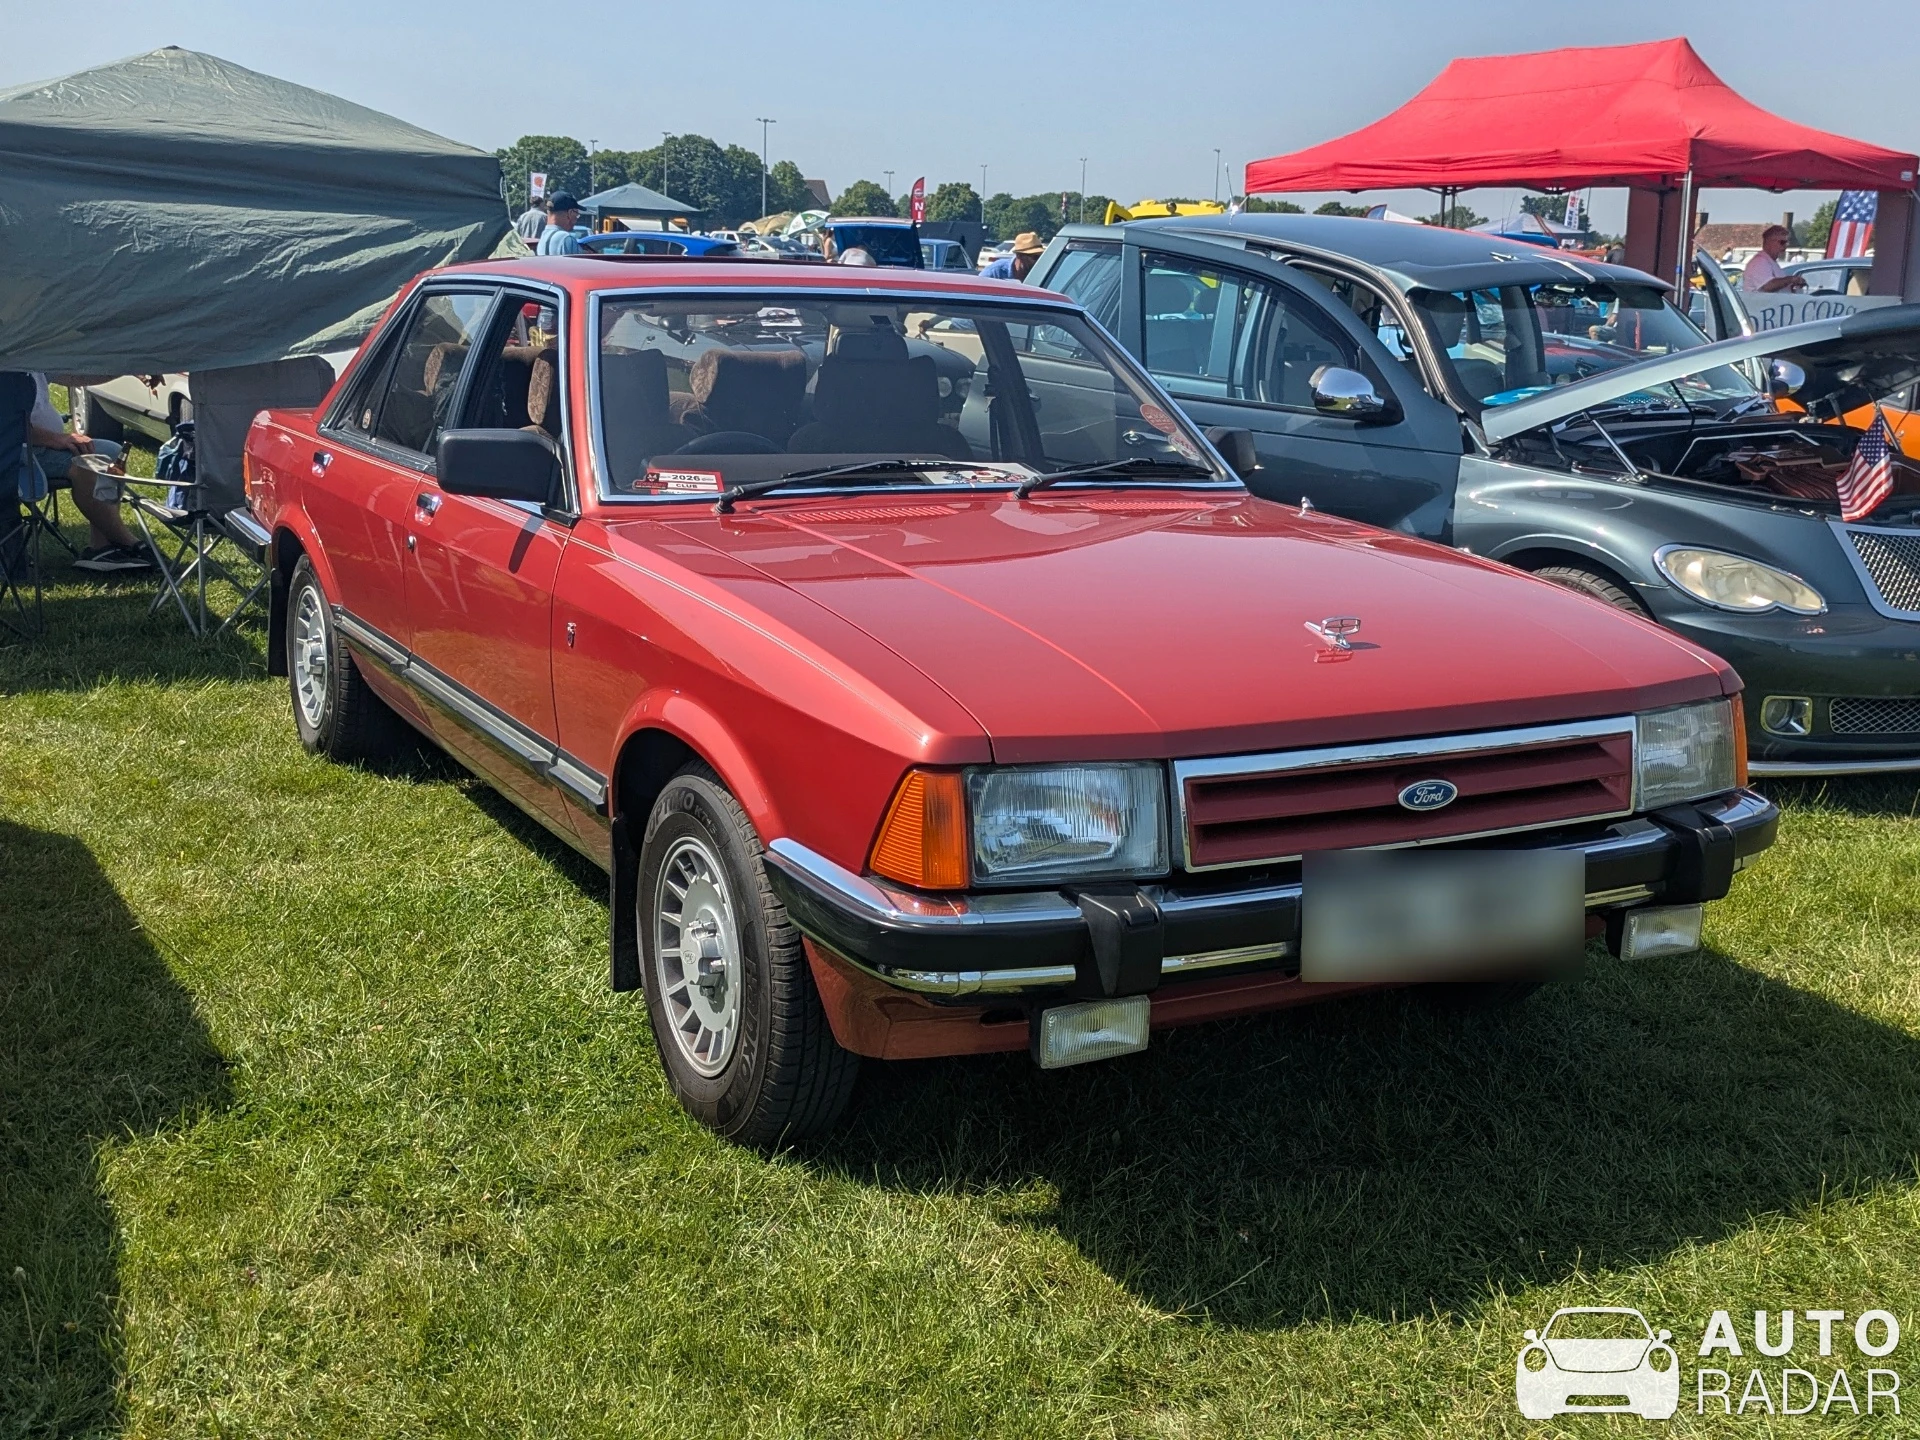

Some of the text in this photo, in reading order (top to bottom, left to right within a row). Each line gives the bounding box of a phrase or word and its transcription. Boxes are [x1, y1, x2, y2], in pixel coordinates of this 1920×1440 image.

[914, 202, 924, 223] NI
[671, 474, 701, 482] 2026
[1413, 786, 1445, 804] Ford
[648, 790, 695, 837] OPTIMO
